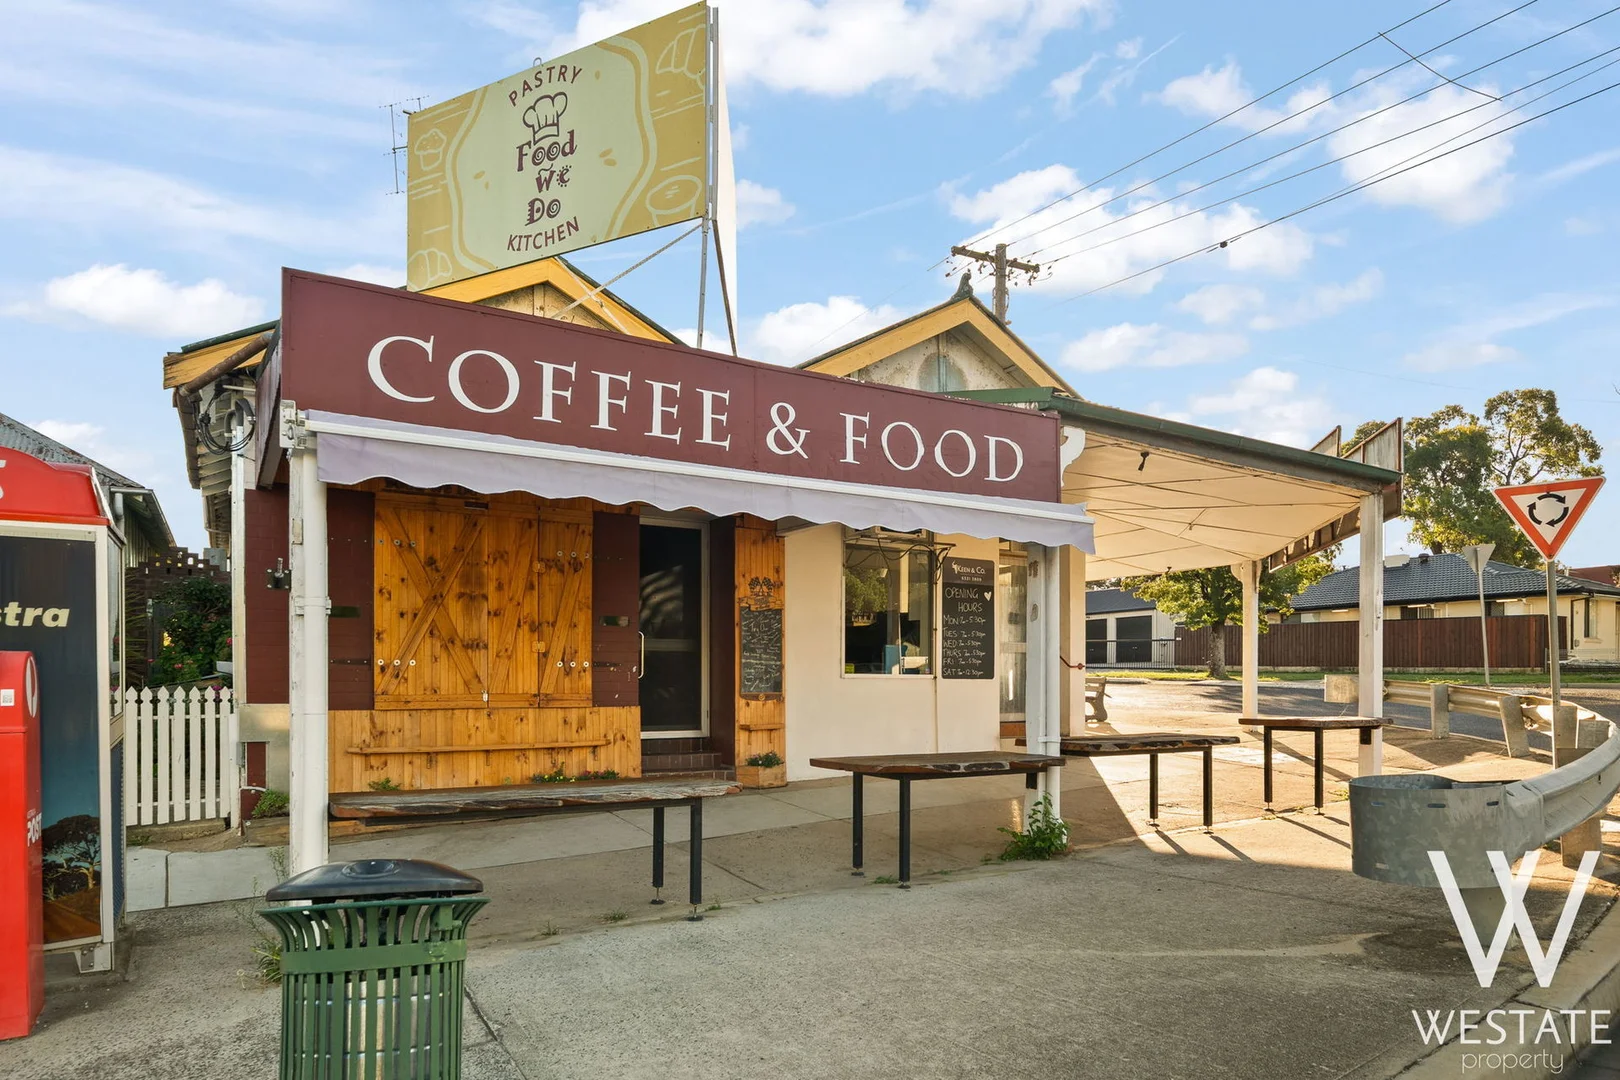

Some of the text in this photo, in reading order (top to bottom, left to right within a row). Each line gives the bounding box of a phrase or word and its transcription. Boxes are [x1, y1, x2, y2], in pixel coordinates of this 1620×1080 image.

[508, 64, 583, 107] PASTRY
[516, 129, 578, 172] Food
[524, 197, 561, 227] Do
[507, 216, 580, 252] KITCHEN
[367, 335, 1024, 482] COFFEE & FOOD
[945, 587, 979, 599] OPENING
[957, 602, 983, 613] HOURS
[0, 601, 70, 628] tra
[943, 614, 959, 625] MON
